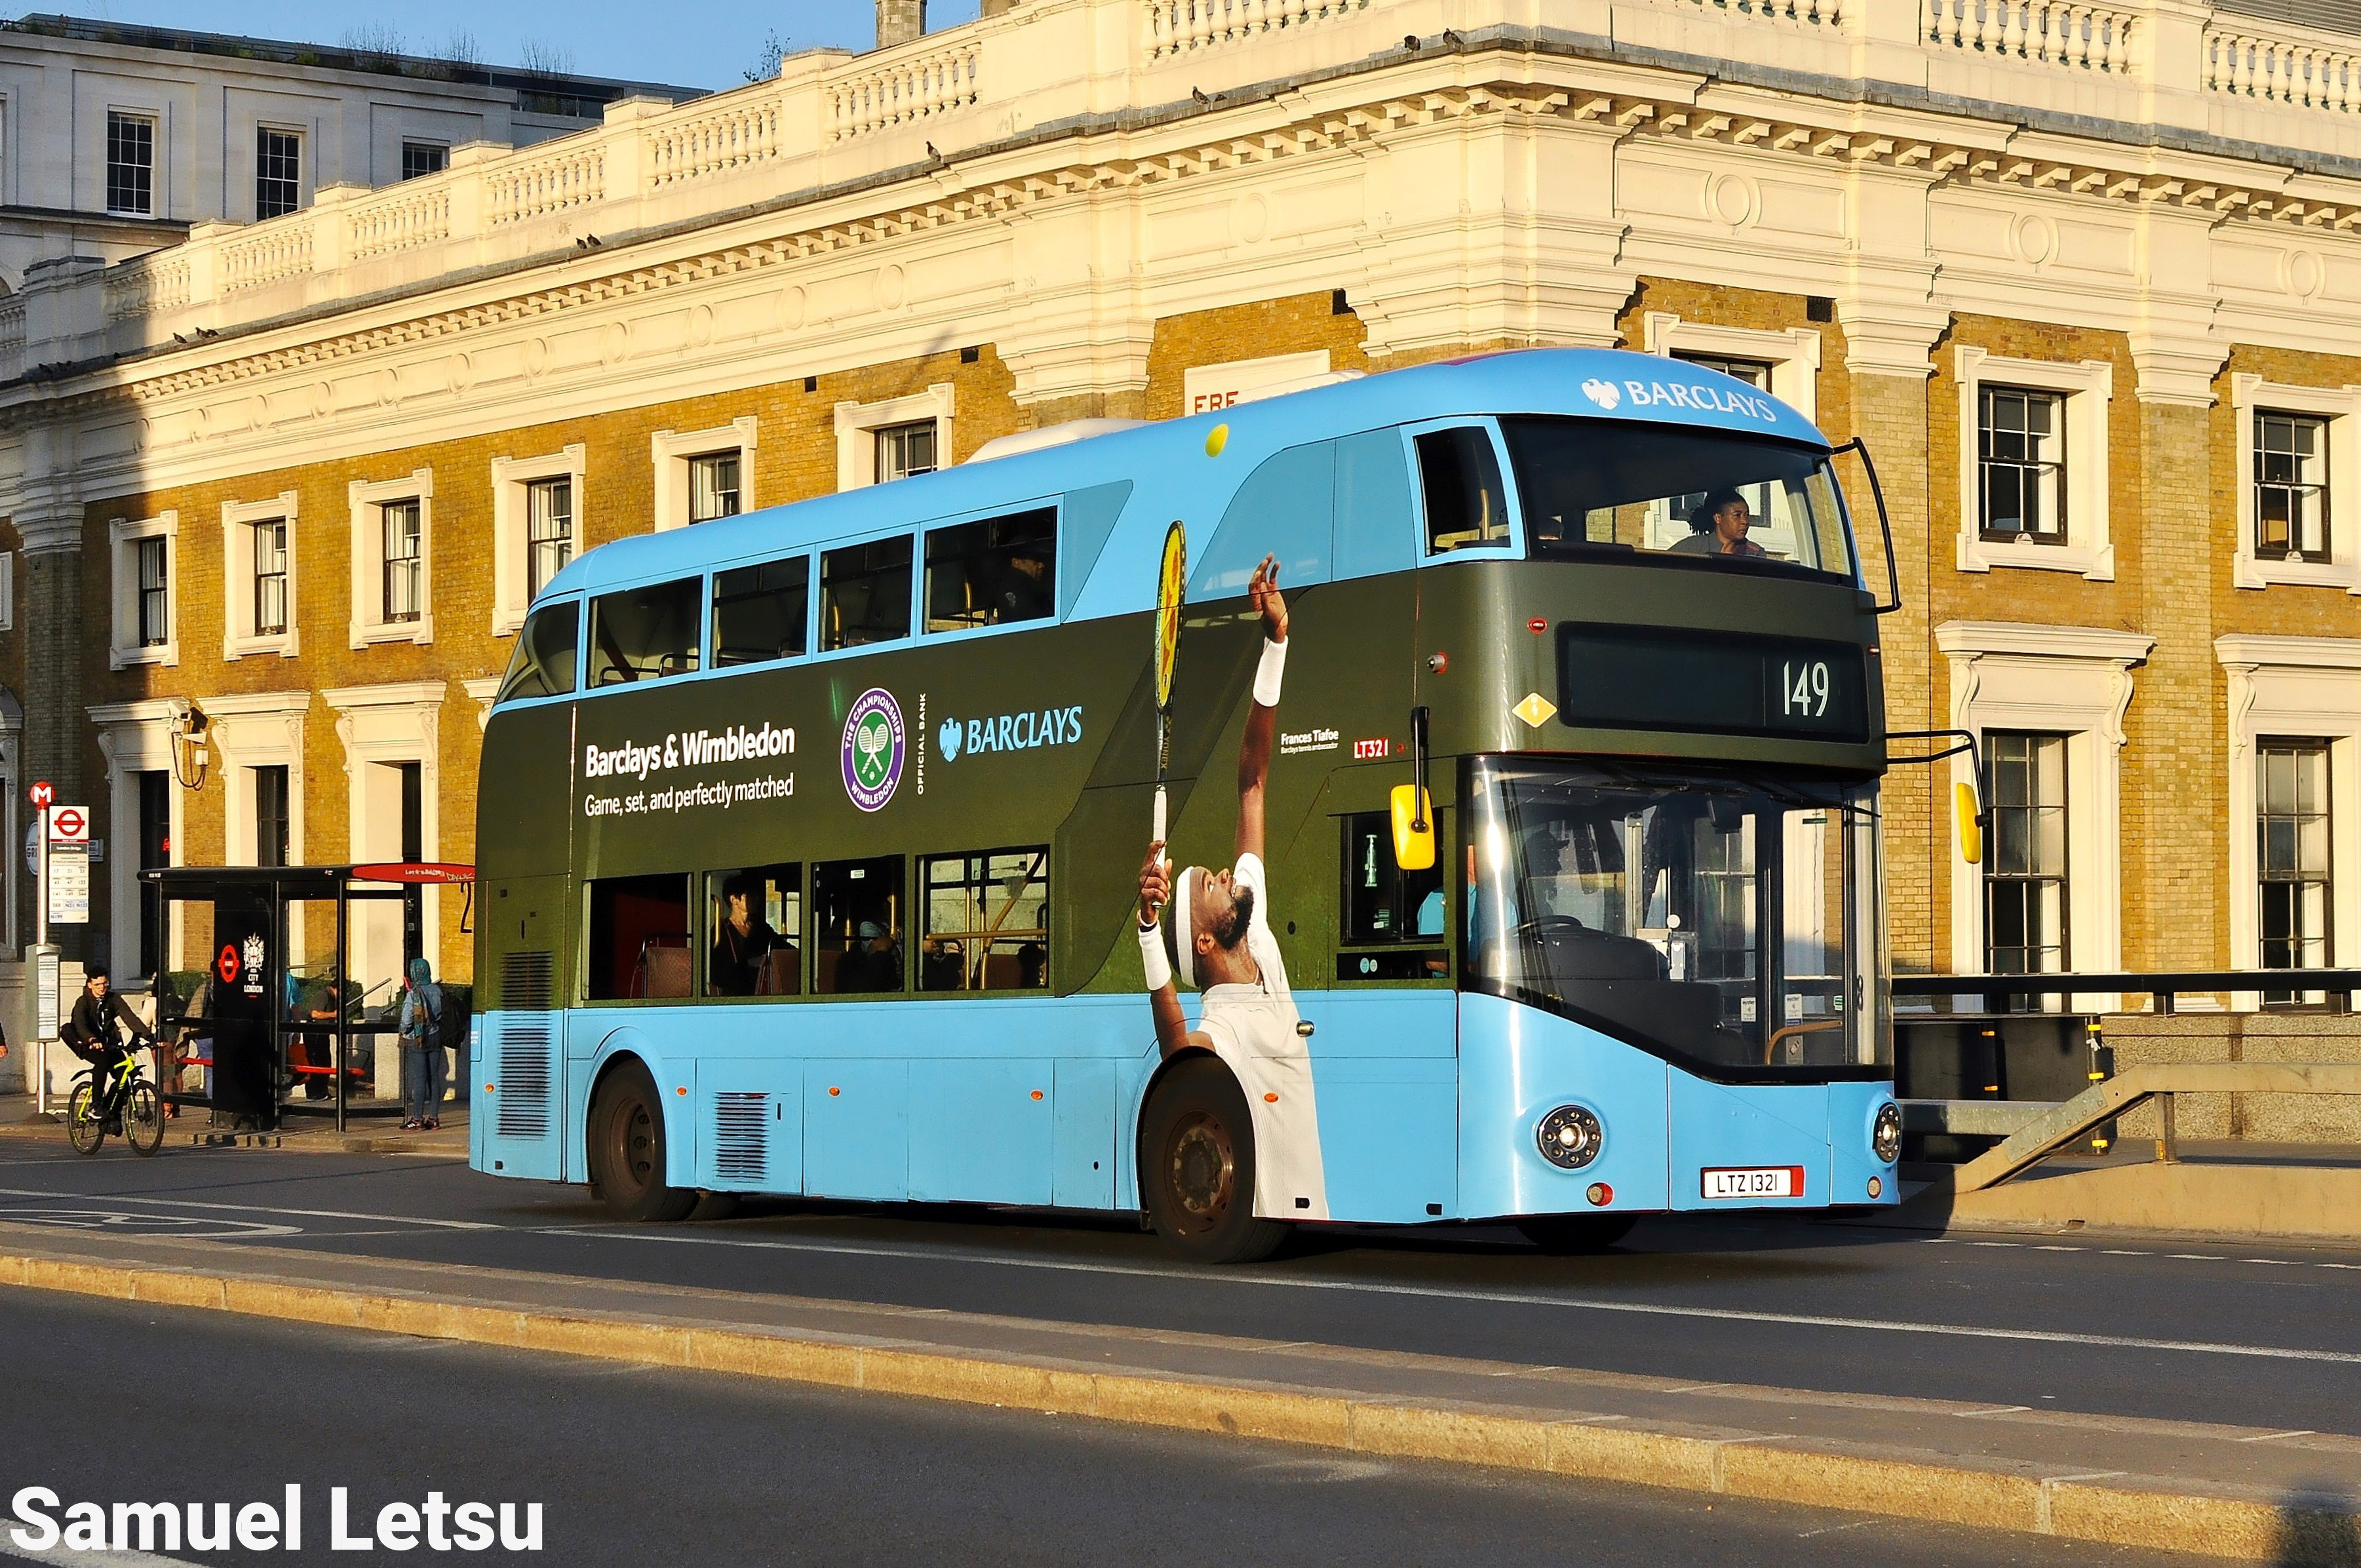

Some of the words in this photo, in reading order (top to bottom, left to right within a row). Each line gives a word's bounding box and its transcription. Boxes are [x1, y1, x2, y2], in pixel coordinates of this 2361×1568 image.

[1624, 381, 1776, 422] BARCLAYS
[1784, 661, 1829, 716] 149
[845, 720, 855, 750] THE
[853, 695, 902, 743] CHAMPIONSHIPS
[967, 706, 1082, 754] BARCLAYS
[1281, 732, 1312, 745] Frances
[1312, 728, 1338, 742] Tiafoe
[586, 740, 661, 781] Barclays
[663, 734, 679, 769] &
[682, 722, 795, 766] Wimbledon
[1161, 736, 1169, 769] YONEX
[1354, 739, 1388, 759] LT321
[34, 787, 51, 803] M
[585, 794, 623, 817] Game,
[625, 791, 648, 814] set,
[650, 786, 673, 810] and
[675, 782, 733, 813] perfectly
[735, 772, 794, 801] matched
[851, 777, 894, 805] WIMBLEDON
[1717, 1175, 1746, 1193] LTZ
[1750, 1173, 1778, 1192] 1321
